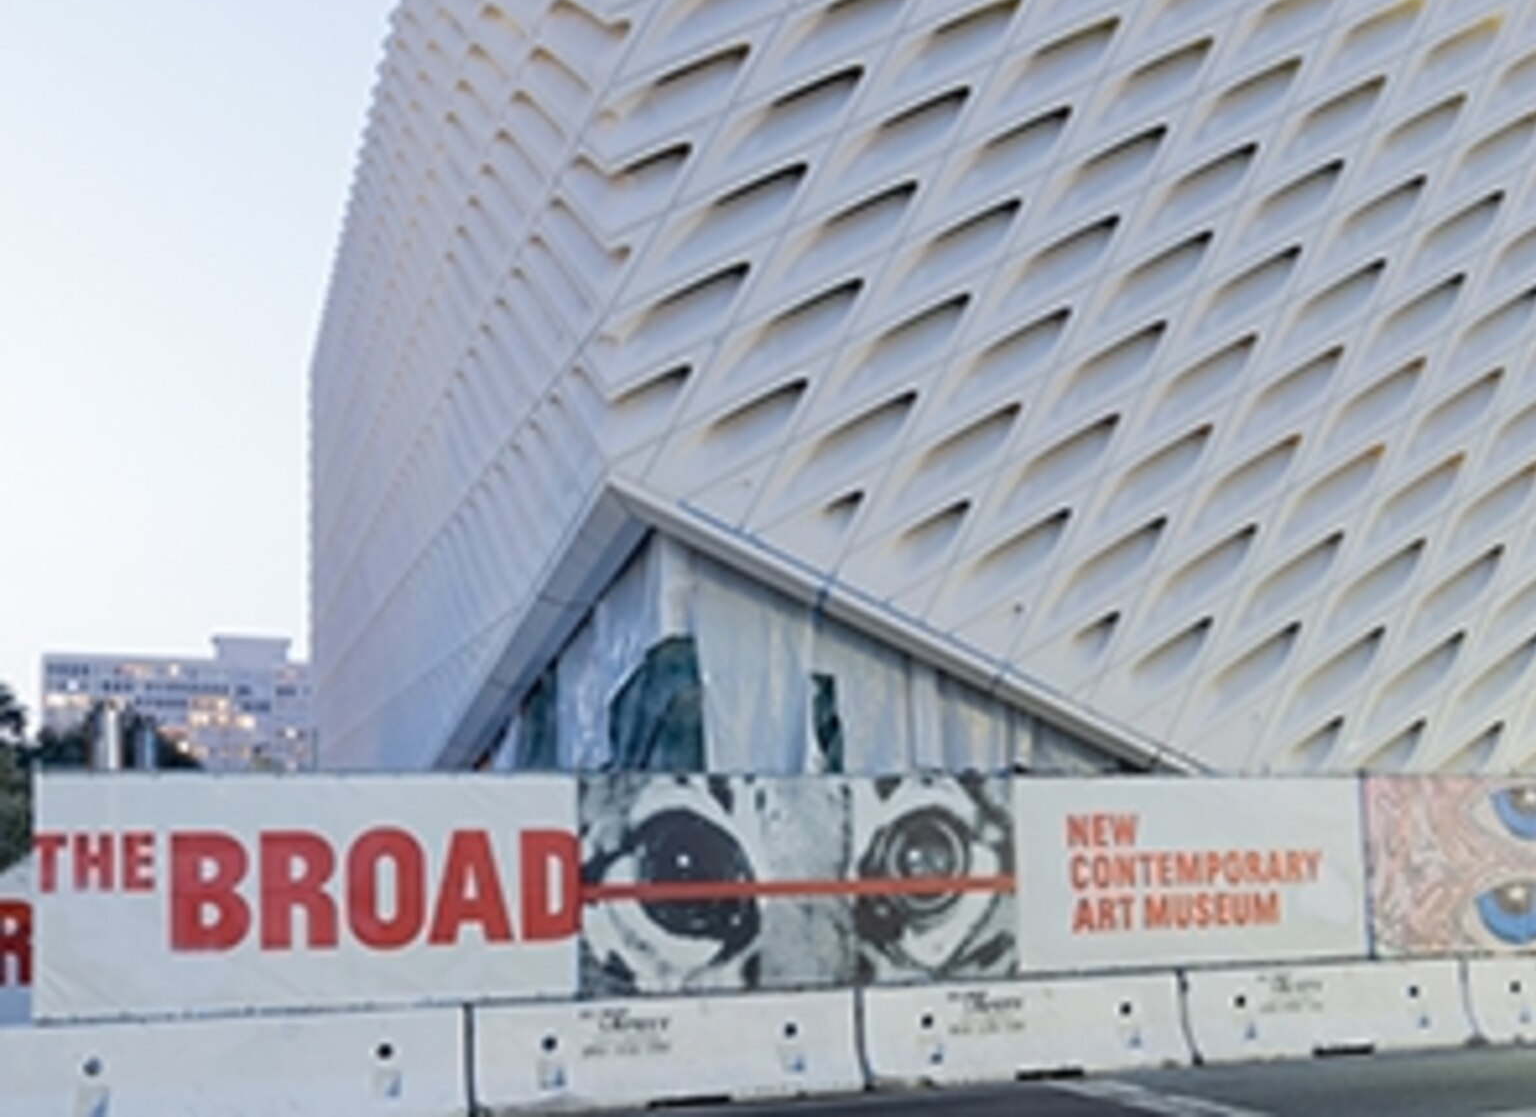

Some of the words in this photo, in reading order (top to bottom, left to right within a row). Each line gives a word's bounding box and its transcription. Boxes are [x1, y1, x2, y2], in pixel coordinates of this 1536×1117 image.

[1066, 812, 1139, 848] NEW
[34, 831, 156, 893] THE
[169, 826, 582, 952] BROAD
[1070, 850, 1323, 890] CONTEMPORARY
[1072, 896, 1135, 933] ART
[1144, 891, 1281, 931] MUSEUM
